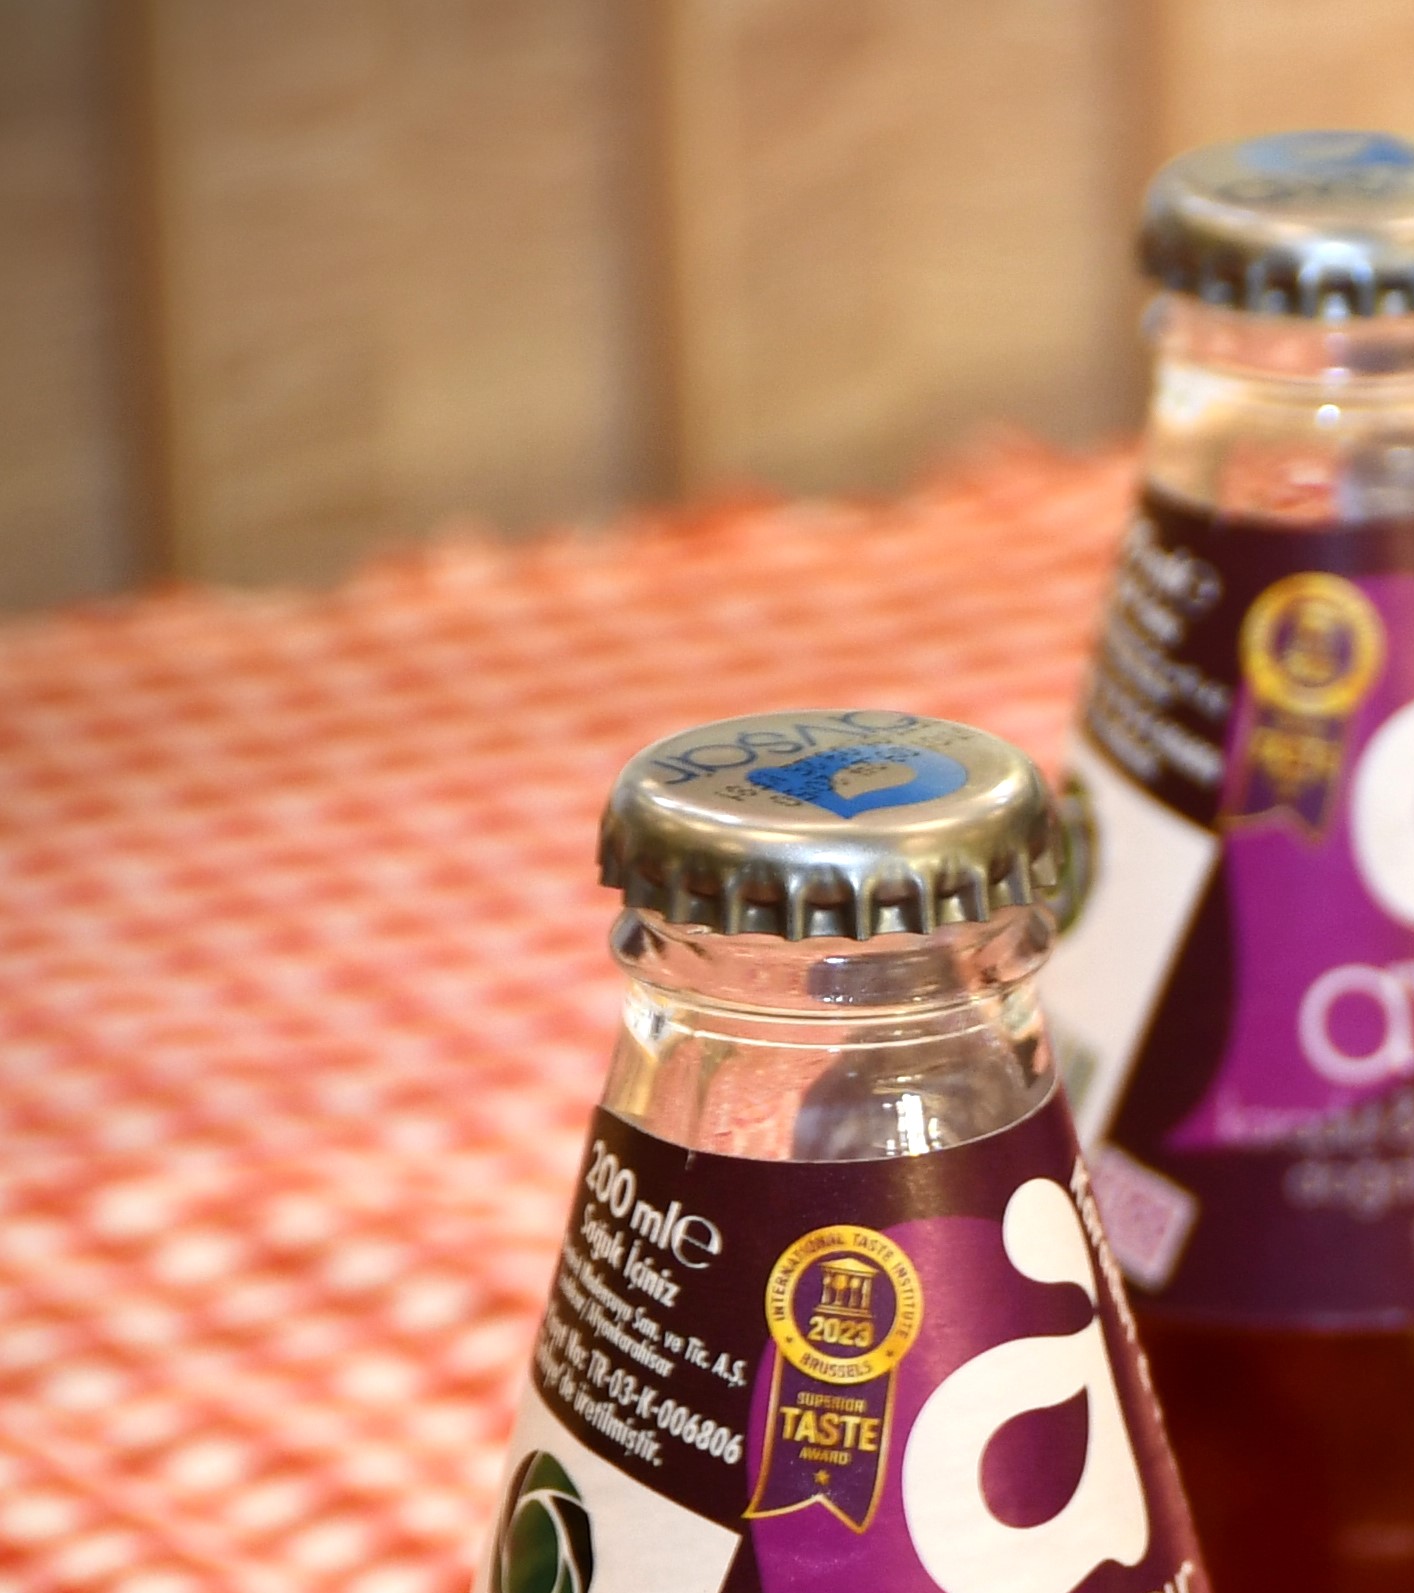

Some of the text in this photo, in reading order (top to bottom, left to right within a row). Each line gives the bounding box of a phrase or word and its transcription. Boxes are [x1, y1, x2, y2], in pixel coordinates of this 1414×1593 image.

[586, 1139, 637, 1218] 200
[852, 1232, 893, 1262] TASTE
[892, 1261, 917, 1340] INSTITUTE
[664, 1330, 681, 1354] ve
[807, 1316, 875, 1348] 2023
[799, 1352, 874, 1379] BRUSSELS
[587, 1349, 744, 1466] TR-03-K-006806
[797, 1391, 866, 1413] SUPERIOR
[780, 1406, 882, 1451] TASTE
[799, 1446, 850, 1466] AWARD
